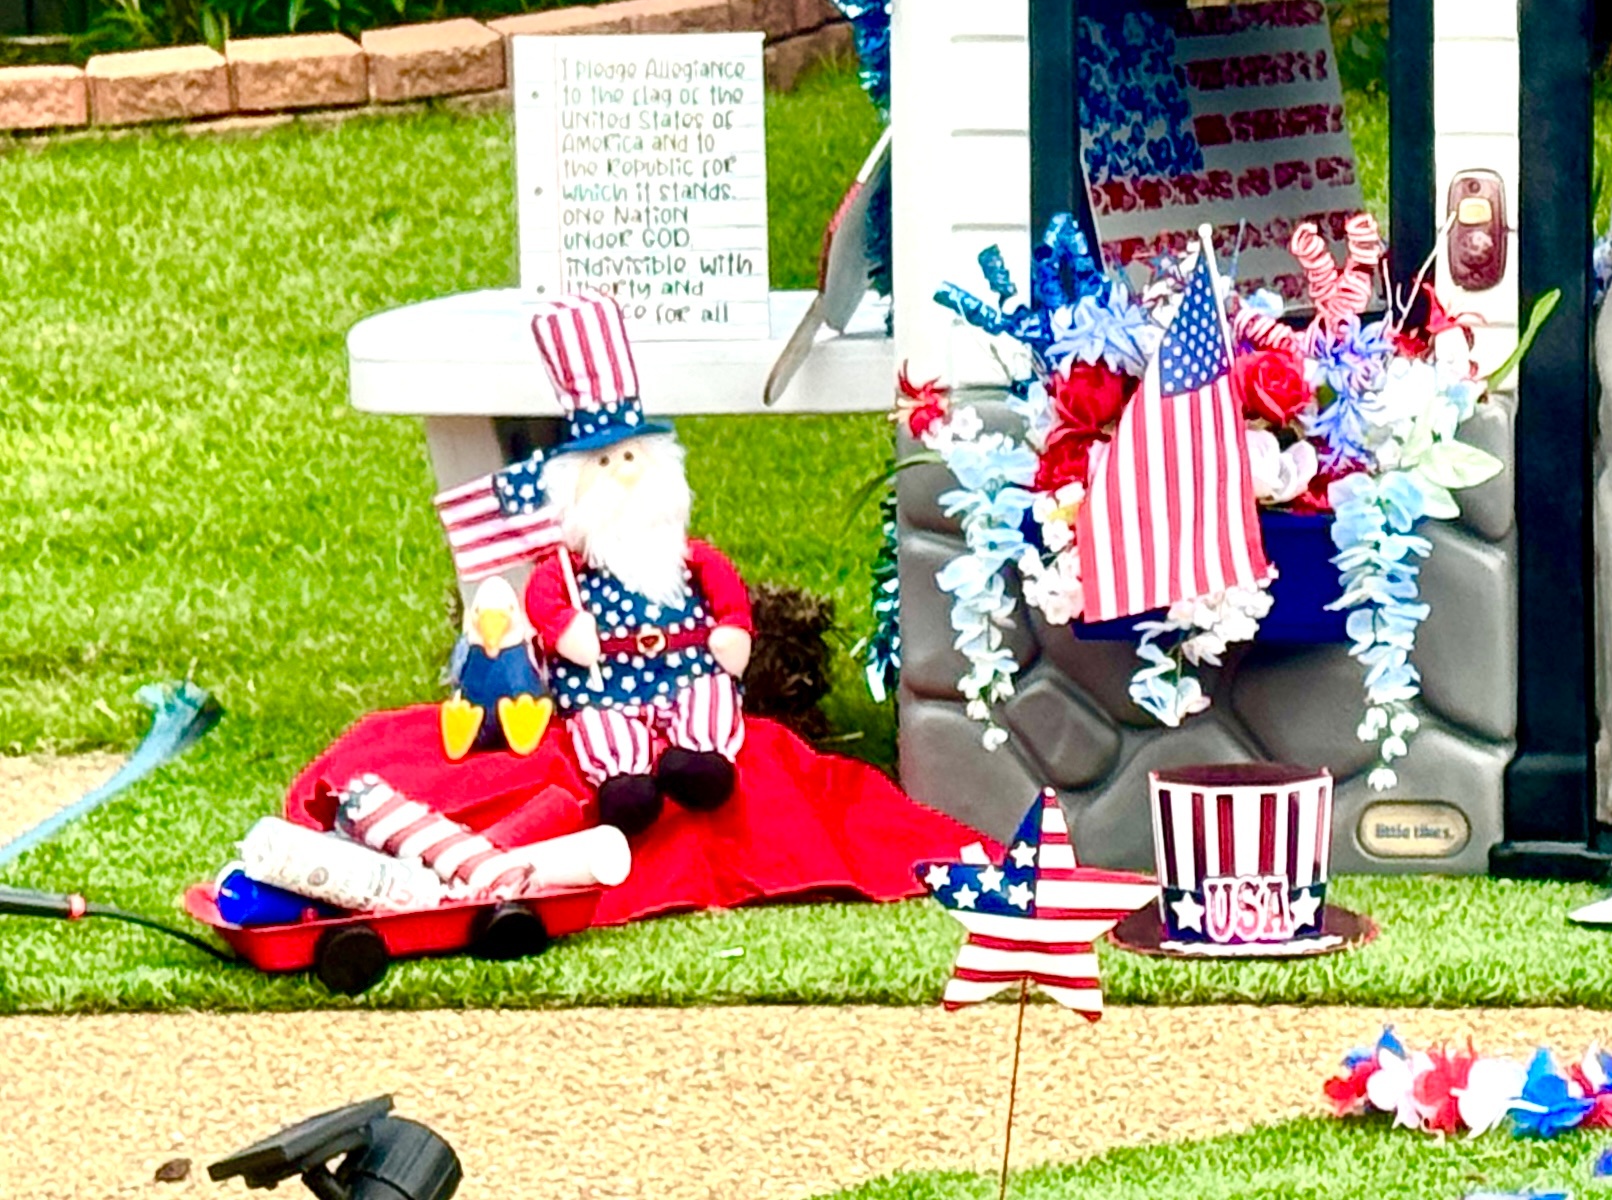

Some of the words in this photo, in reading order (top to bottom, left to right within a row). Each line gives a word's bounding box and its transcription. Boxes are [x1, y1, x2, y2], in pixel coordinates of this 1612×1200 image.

[563, 85, 582, 106] to
[591, 85, 624, 105] the
[680, 87, 700, 106] of
[710, 85, 744, 106] the
[713, 110, 734, 130] of
[697, 131, 715, 154] to
[564, 157, 598, 178] the
[562, 182, 628, 202] which
[635, 182, 650, 203] it
[700, 253, 753, 276] with
[701, 302, 729, 323] all
[1205, 877, 1294, 940] USA
